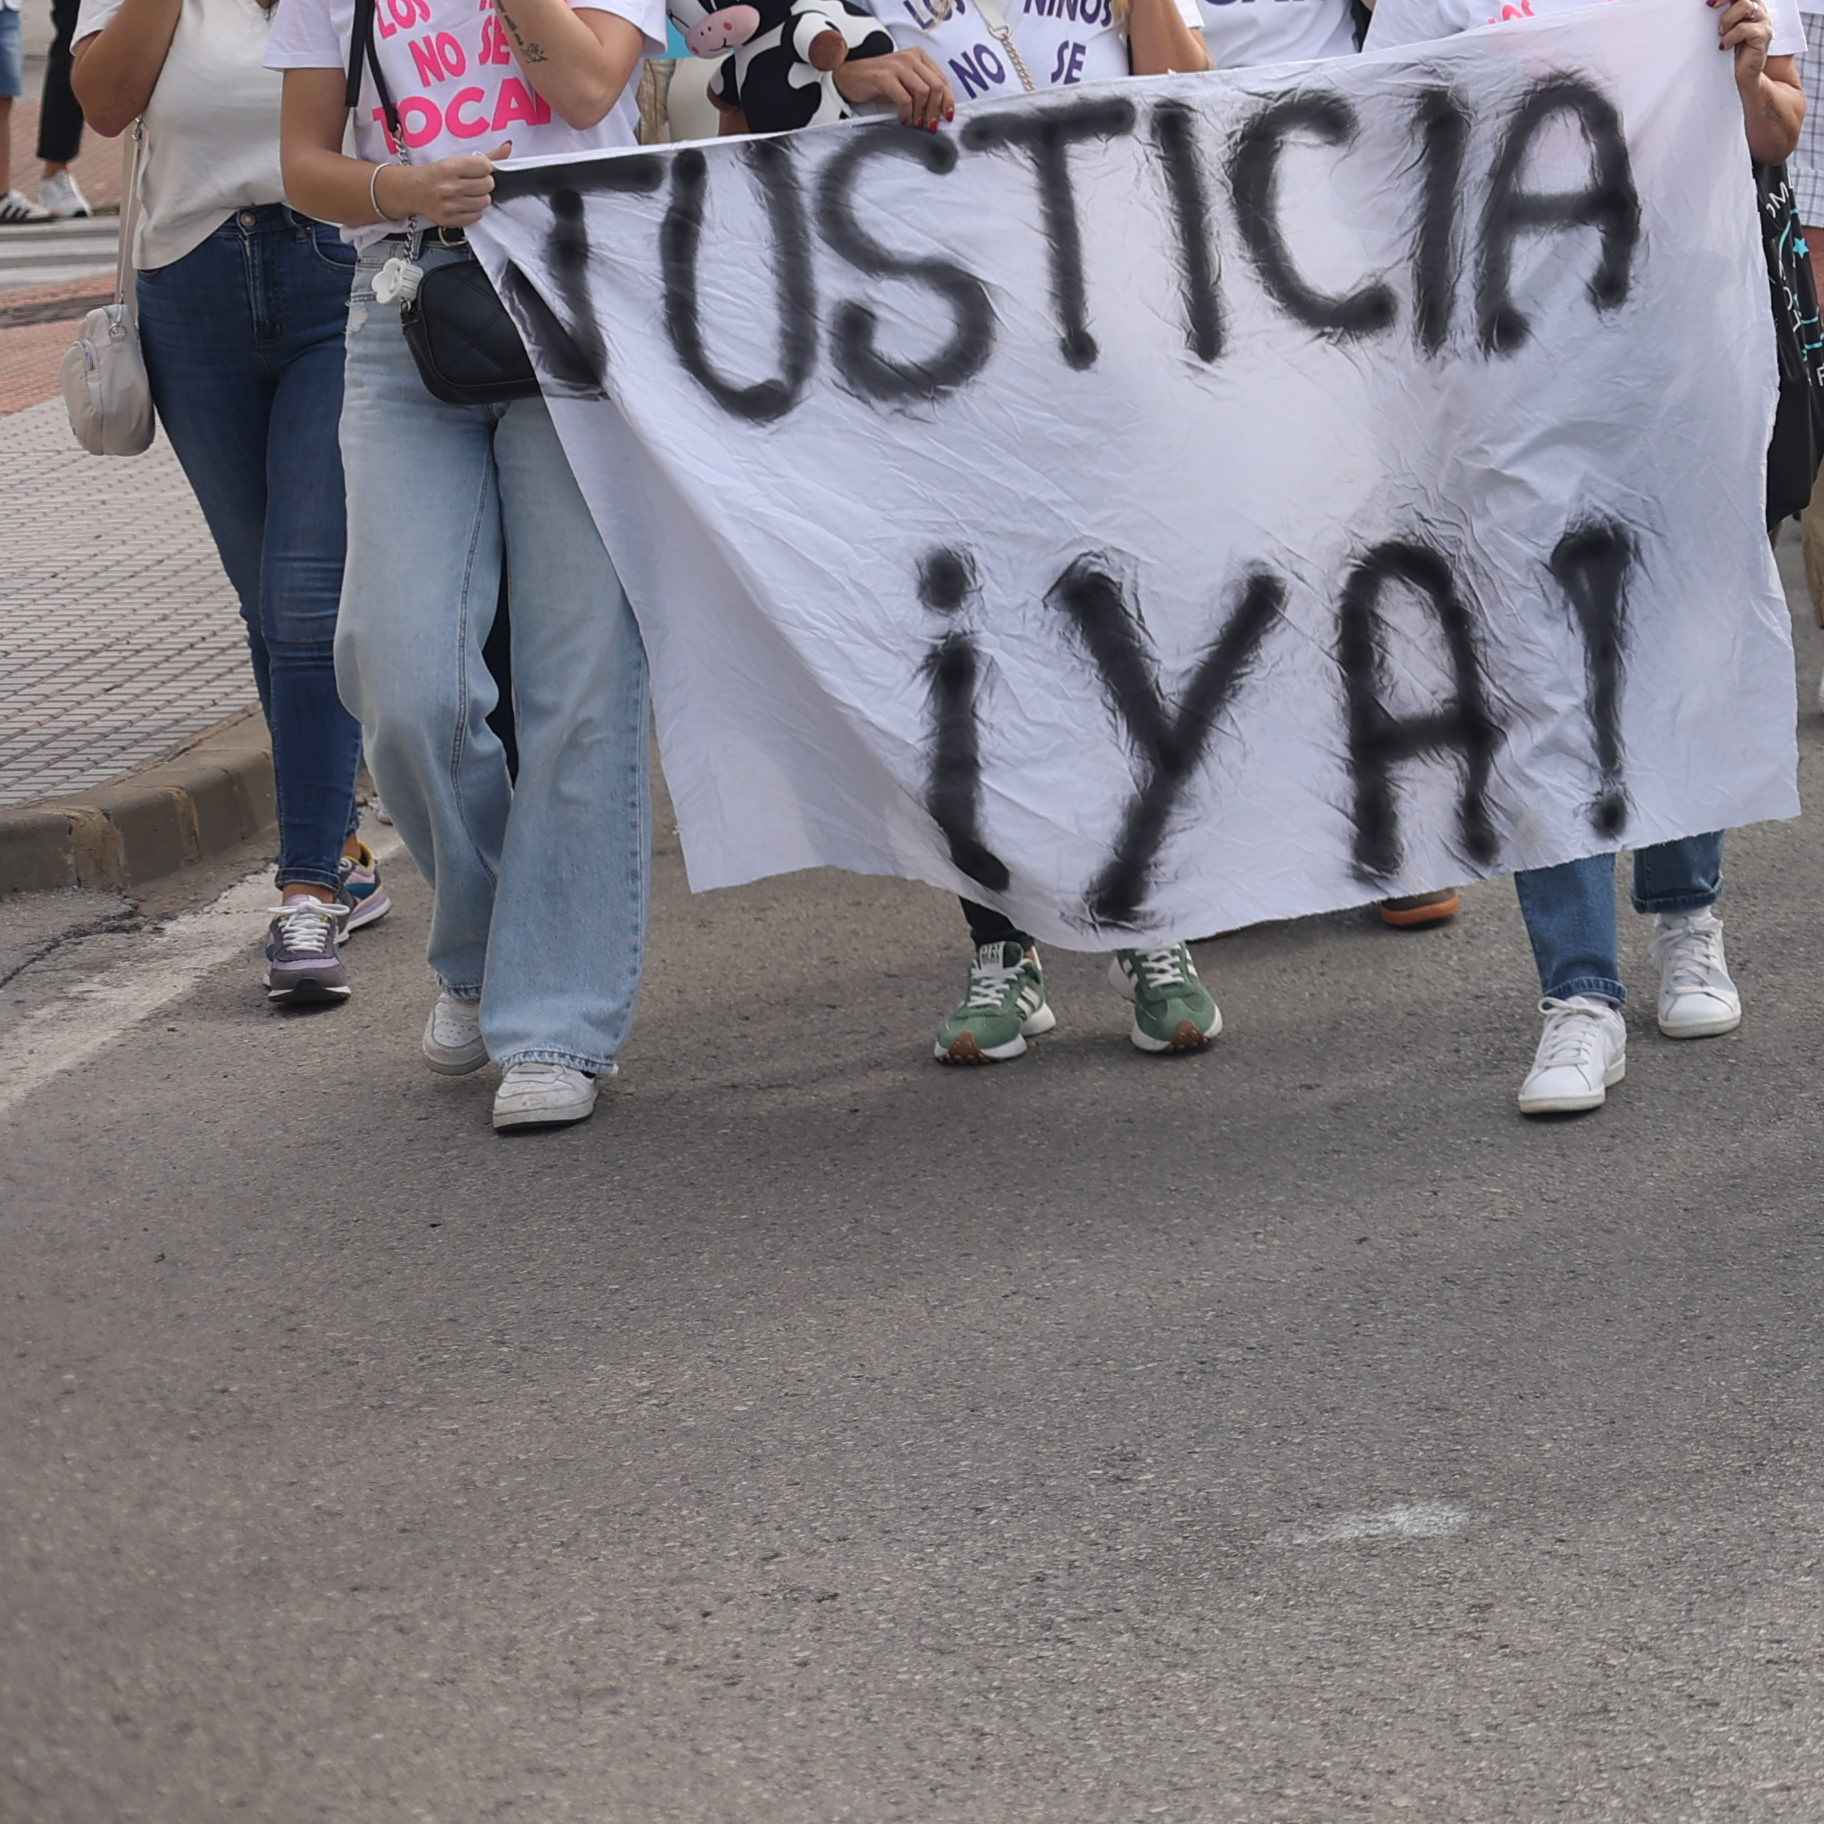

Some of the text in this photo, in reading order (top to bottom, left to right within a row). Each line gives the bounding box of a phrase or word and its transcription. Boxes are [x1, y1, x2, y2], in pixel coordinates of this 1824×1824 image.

[408, 31, 467, 88] NO
[947, 39, 1088, 100] NO SE
[494, 69, 1643, 425] JUSTICIA
